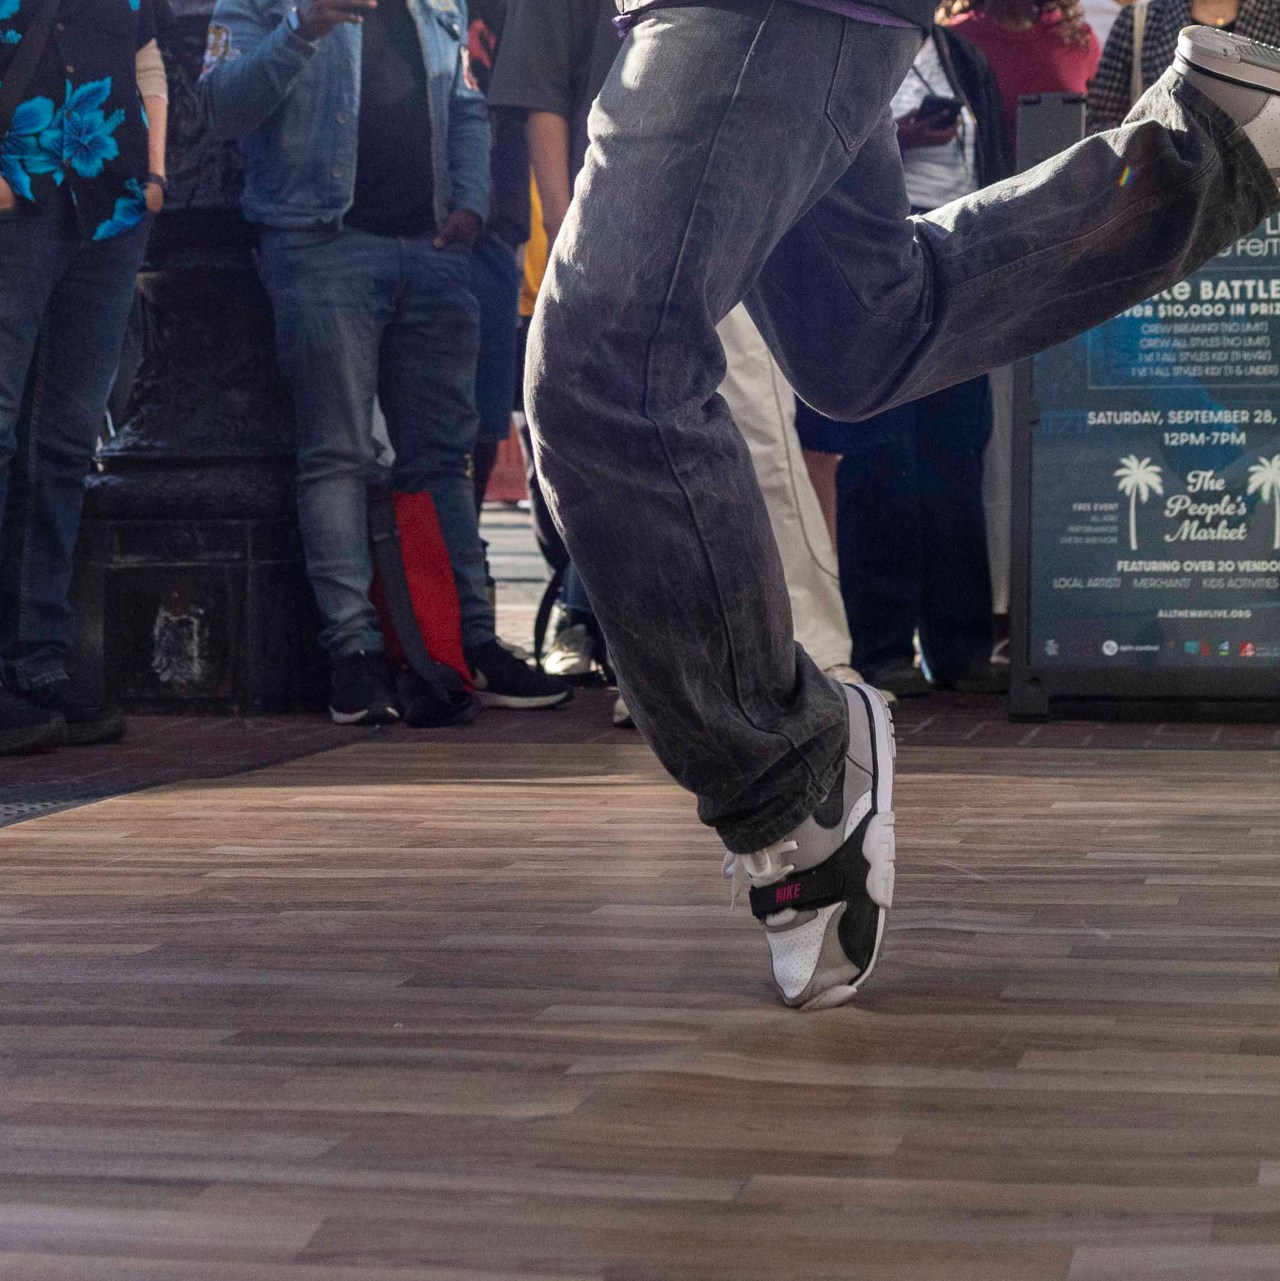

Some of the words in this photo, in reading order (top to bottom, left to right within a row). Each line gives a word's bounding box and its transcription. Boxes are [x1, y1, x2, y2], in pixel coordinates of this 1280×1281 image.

[1158, 303, 1225, 318] $10,000
[1230, 303, 1247, 317] IN
[1087, 410, 1163, 426] SATURDAY,
[1168, 410, 1249, 425] SEPTEMBER
[1254, 409, 1277, 424] 28,
[1163, 432, 1246, 447] 12PM-7PM
[1187, 470, 1226, 493] The
[1093, 503, 1119, 512] EVENT
[1164, 494, 1247, 523] People's
[1164, 519, 1248, 542] Market
[1117, 560, 1181, 572] FEATURING
[1183, 560, 1215, 572] OVER
[1217, 560, 1235, 572] 20
[1053, 578, 1084, 589] LOCAL
[1202, 577, 1225, 589] KIDS
[1227, 577, 1279, 589] ACTIVITIES
[775, 882, 801, 904] NIKE
